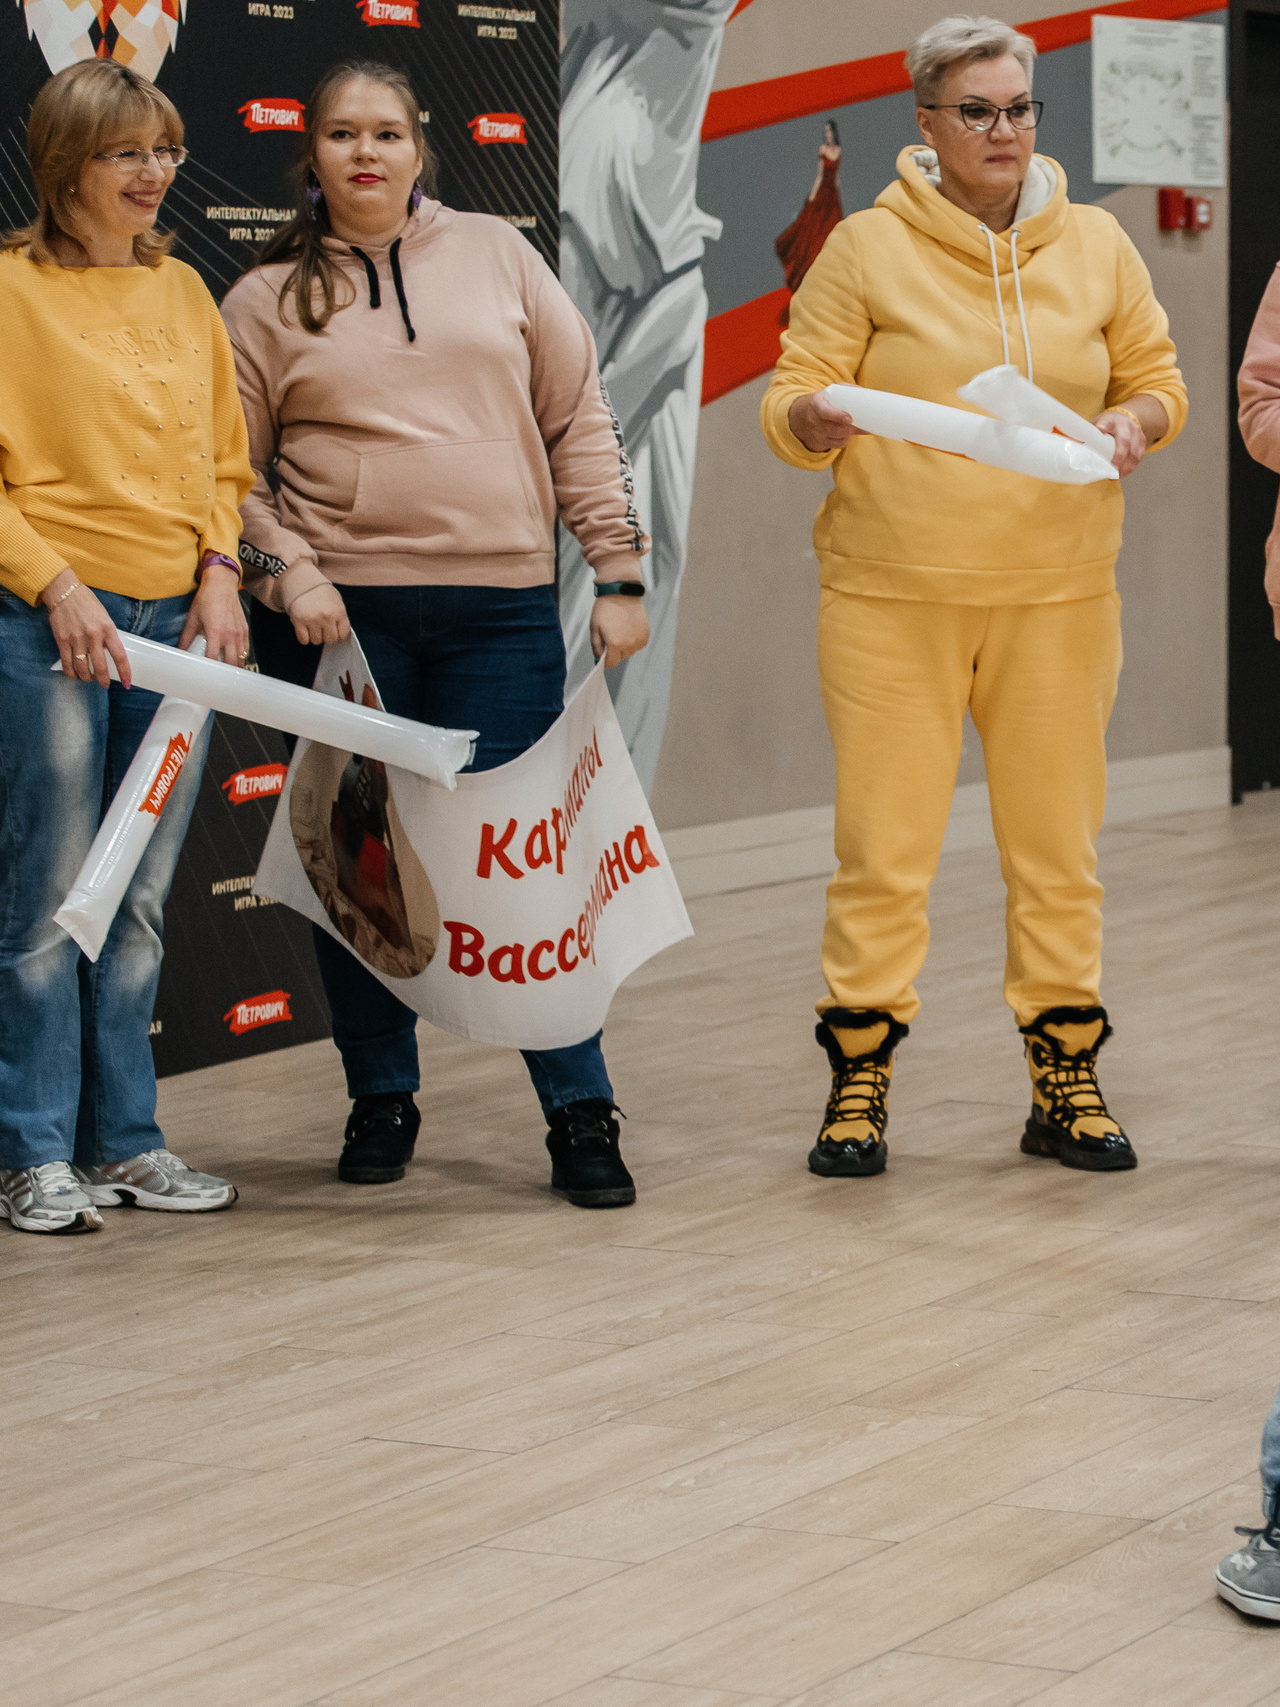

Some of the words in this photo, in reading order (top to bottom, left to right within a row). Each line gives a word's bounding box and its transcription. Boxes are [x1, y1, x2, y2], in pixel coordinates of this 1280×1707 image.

[248, 3, 271, 17] ИГРА
[273, 5, 294, 19] 2023
[368, 0, 413, 21] ПЕТРОВИЧ
[477, 25, 497, 38] ИГРА
[251, 103, 299, 126] ПЕТРОВИЧ
[479, 117, 520, 138] ПЕТРОВИЧ
[229, 228, 252, 240] ИГРА
[149, 744, 186, 810] ПЕТРОВИЧ
[235, 773, 283, 795] ПЕТРОВИЧ
[476, 725, 603, 880] Карманы
[234, 894, 257, 911] ИГРА
[443, 825, 661, 985] Вассермана
[236, 1001, 284, 1025] ПЕТРОВИЧ
